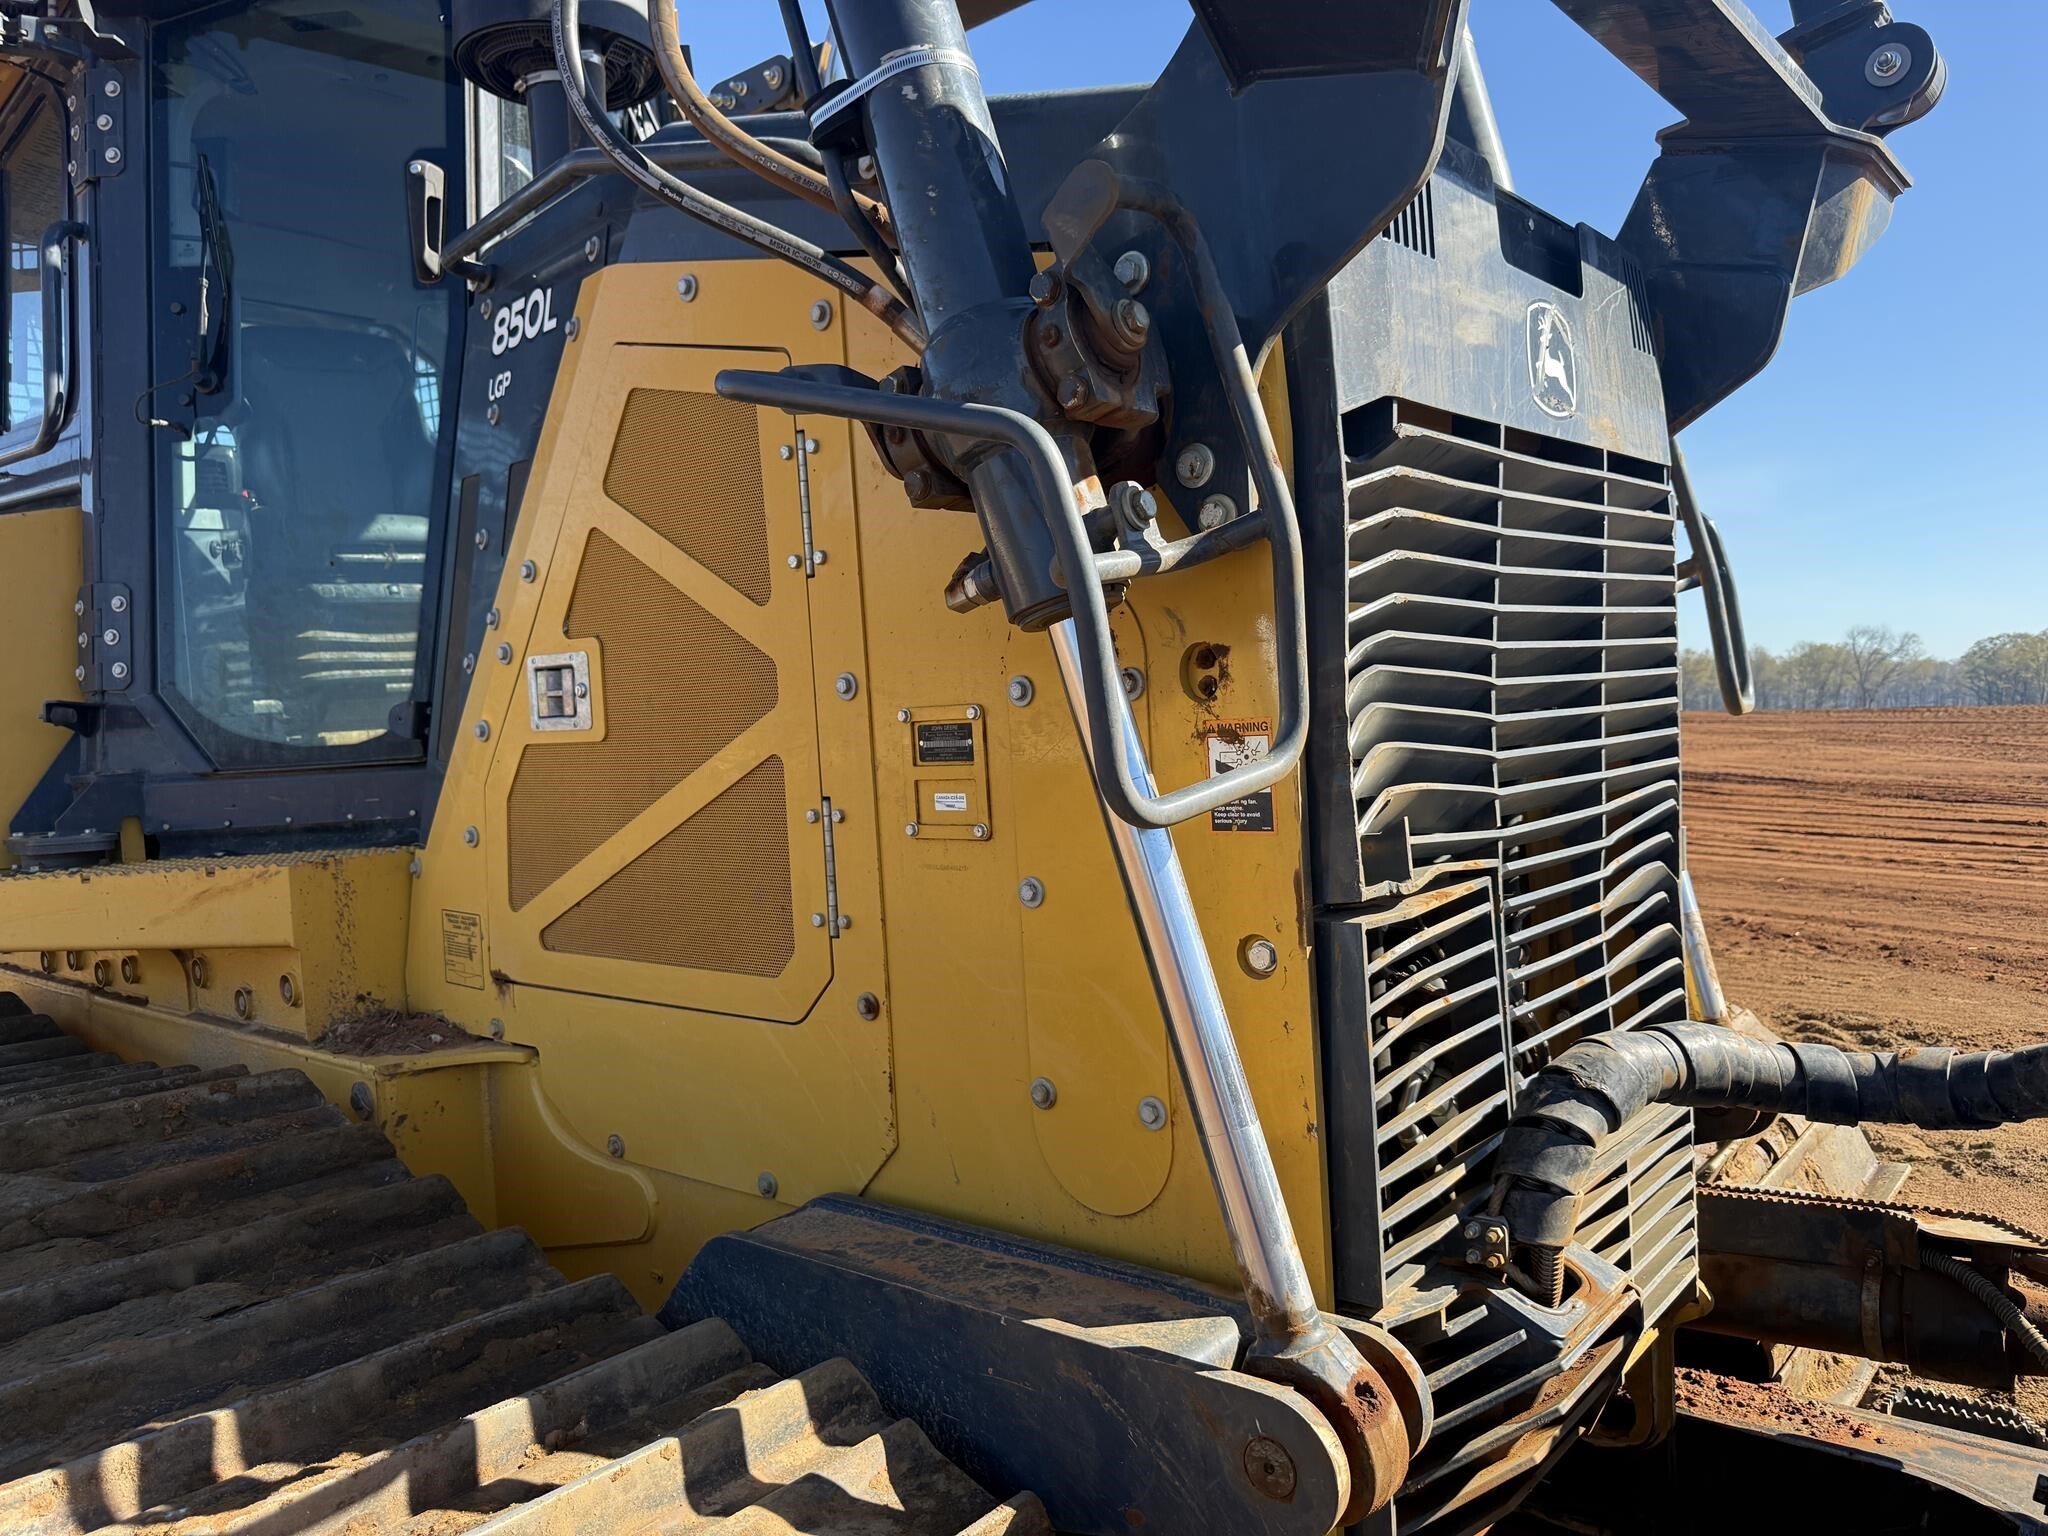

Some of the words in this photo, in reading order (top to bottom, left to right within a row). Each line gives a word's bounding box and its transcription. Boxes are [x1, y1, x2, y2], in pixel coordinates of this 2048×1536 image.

[769, 238, 791, 255] MSHA
[491, 287, 557, 356] 850L
[488, 370, 511, 401] LGP
[1216, 721, 1269, 734] WARNING
